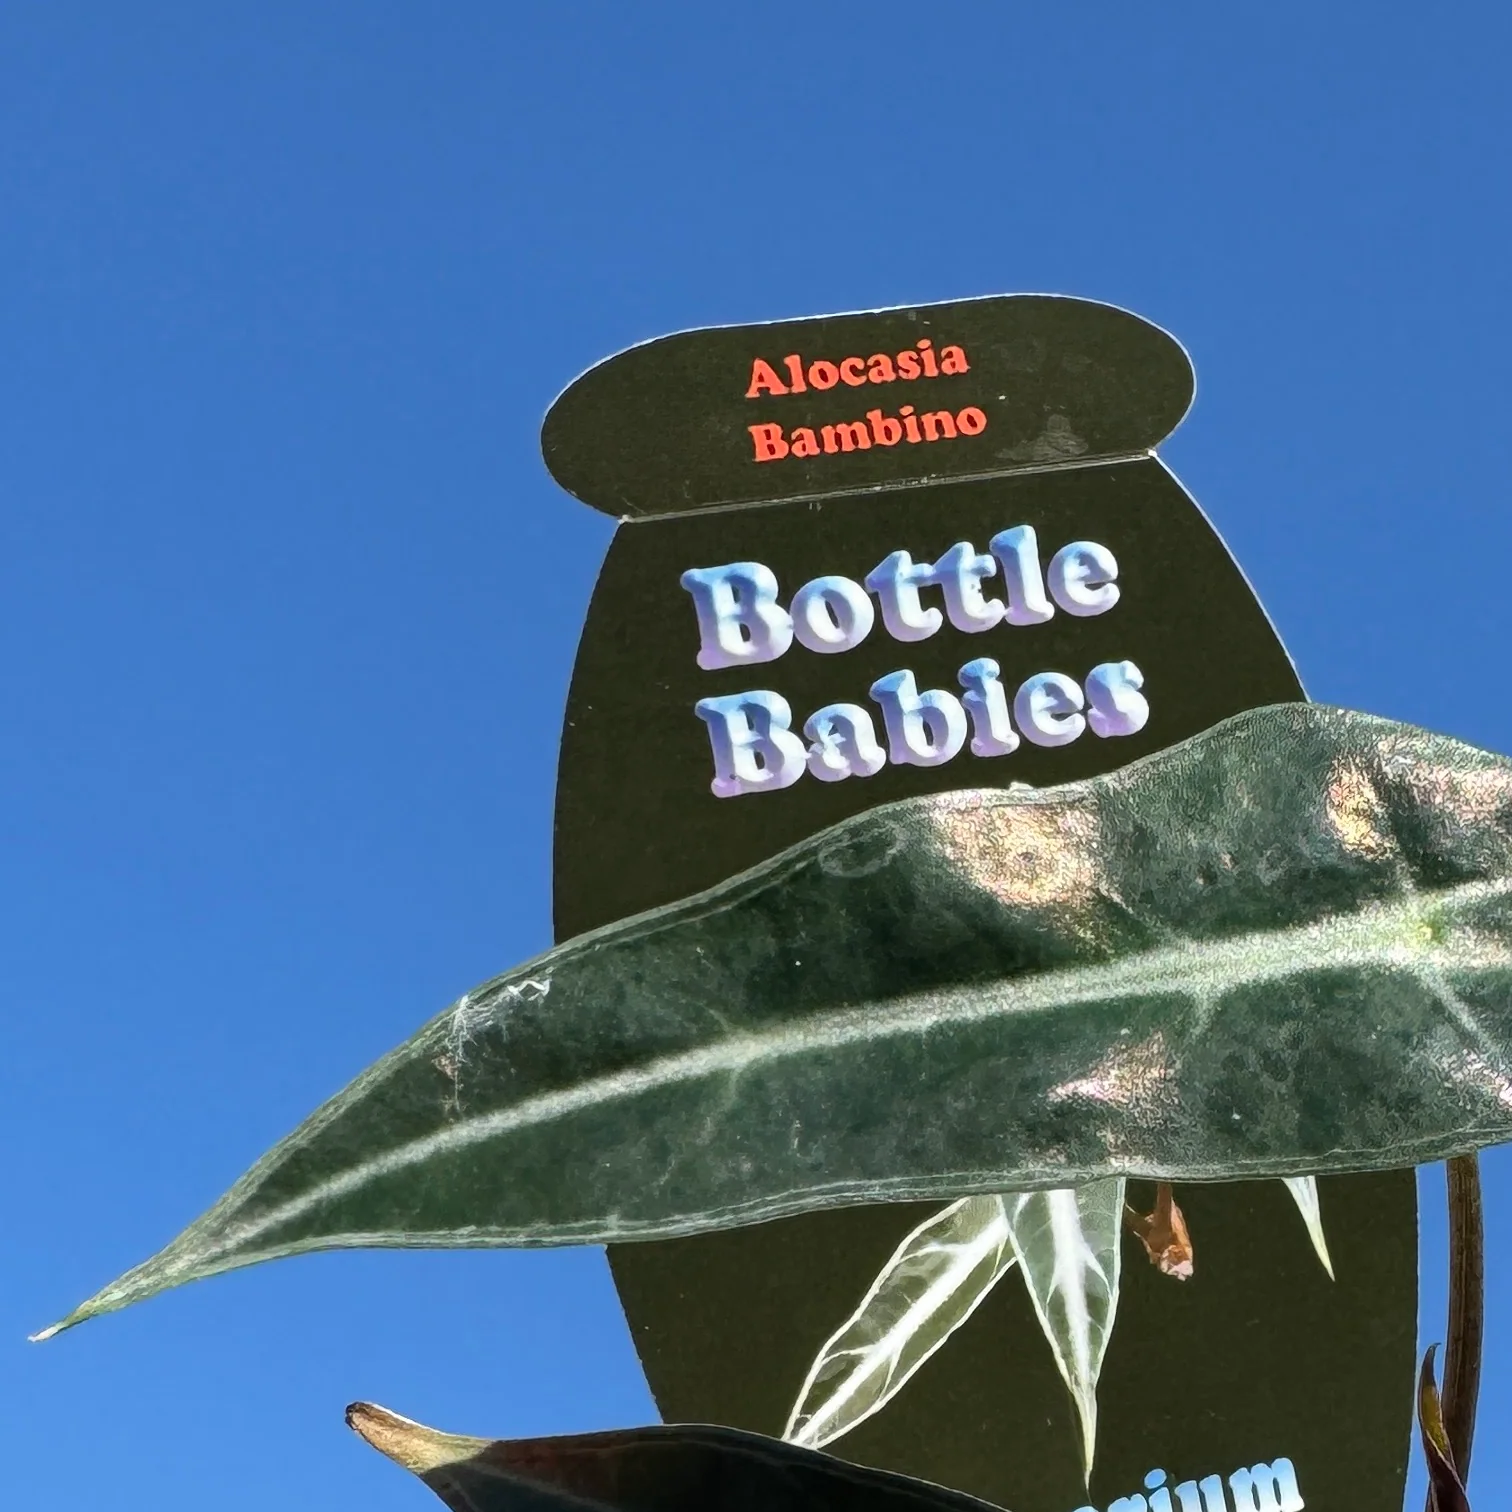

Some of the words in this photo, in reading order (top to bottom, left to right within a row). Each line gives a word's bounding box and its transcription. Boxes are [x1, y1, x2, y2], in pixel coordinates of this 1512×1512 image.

[746, 339, 970, 398] Alocasia
[748, 405, 988, 462] Bambino
[680, 525, 1121, 670] Bottle
[695, 658, 1150, 798] Babies
